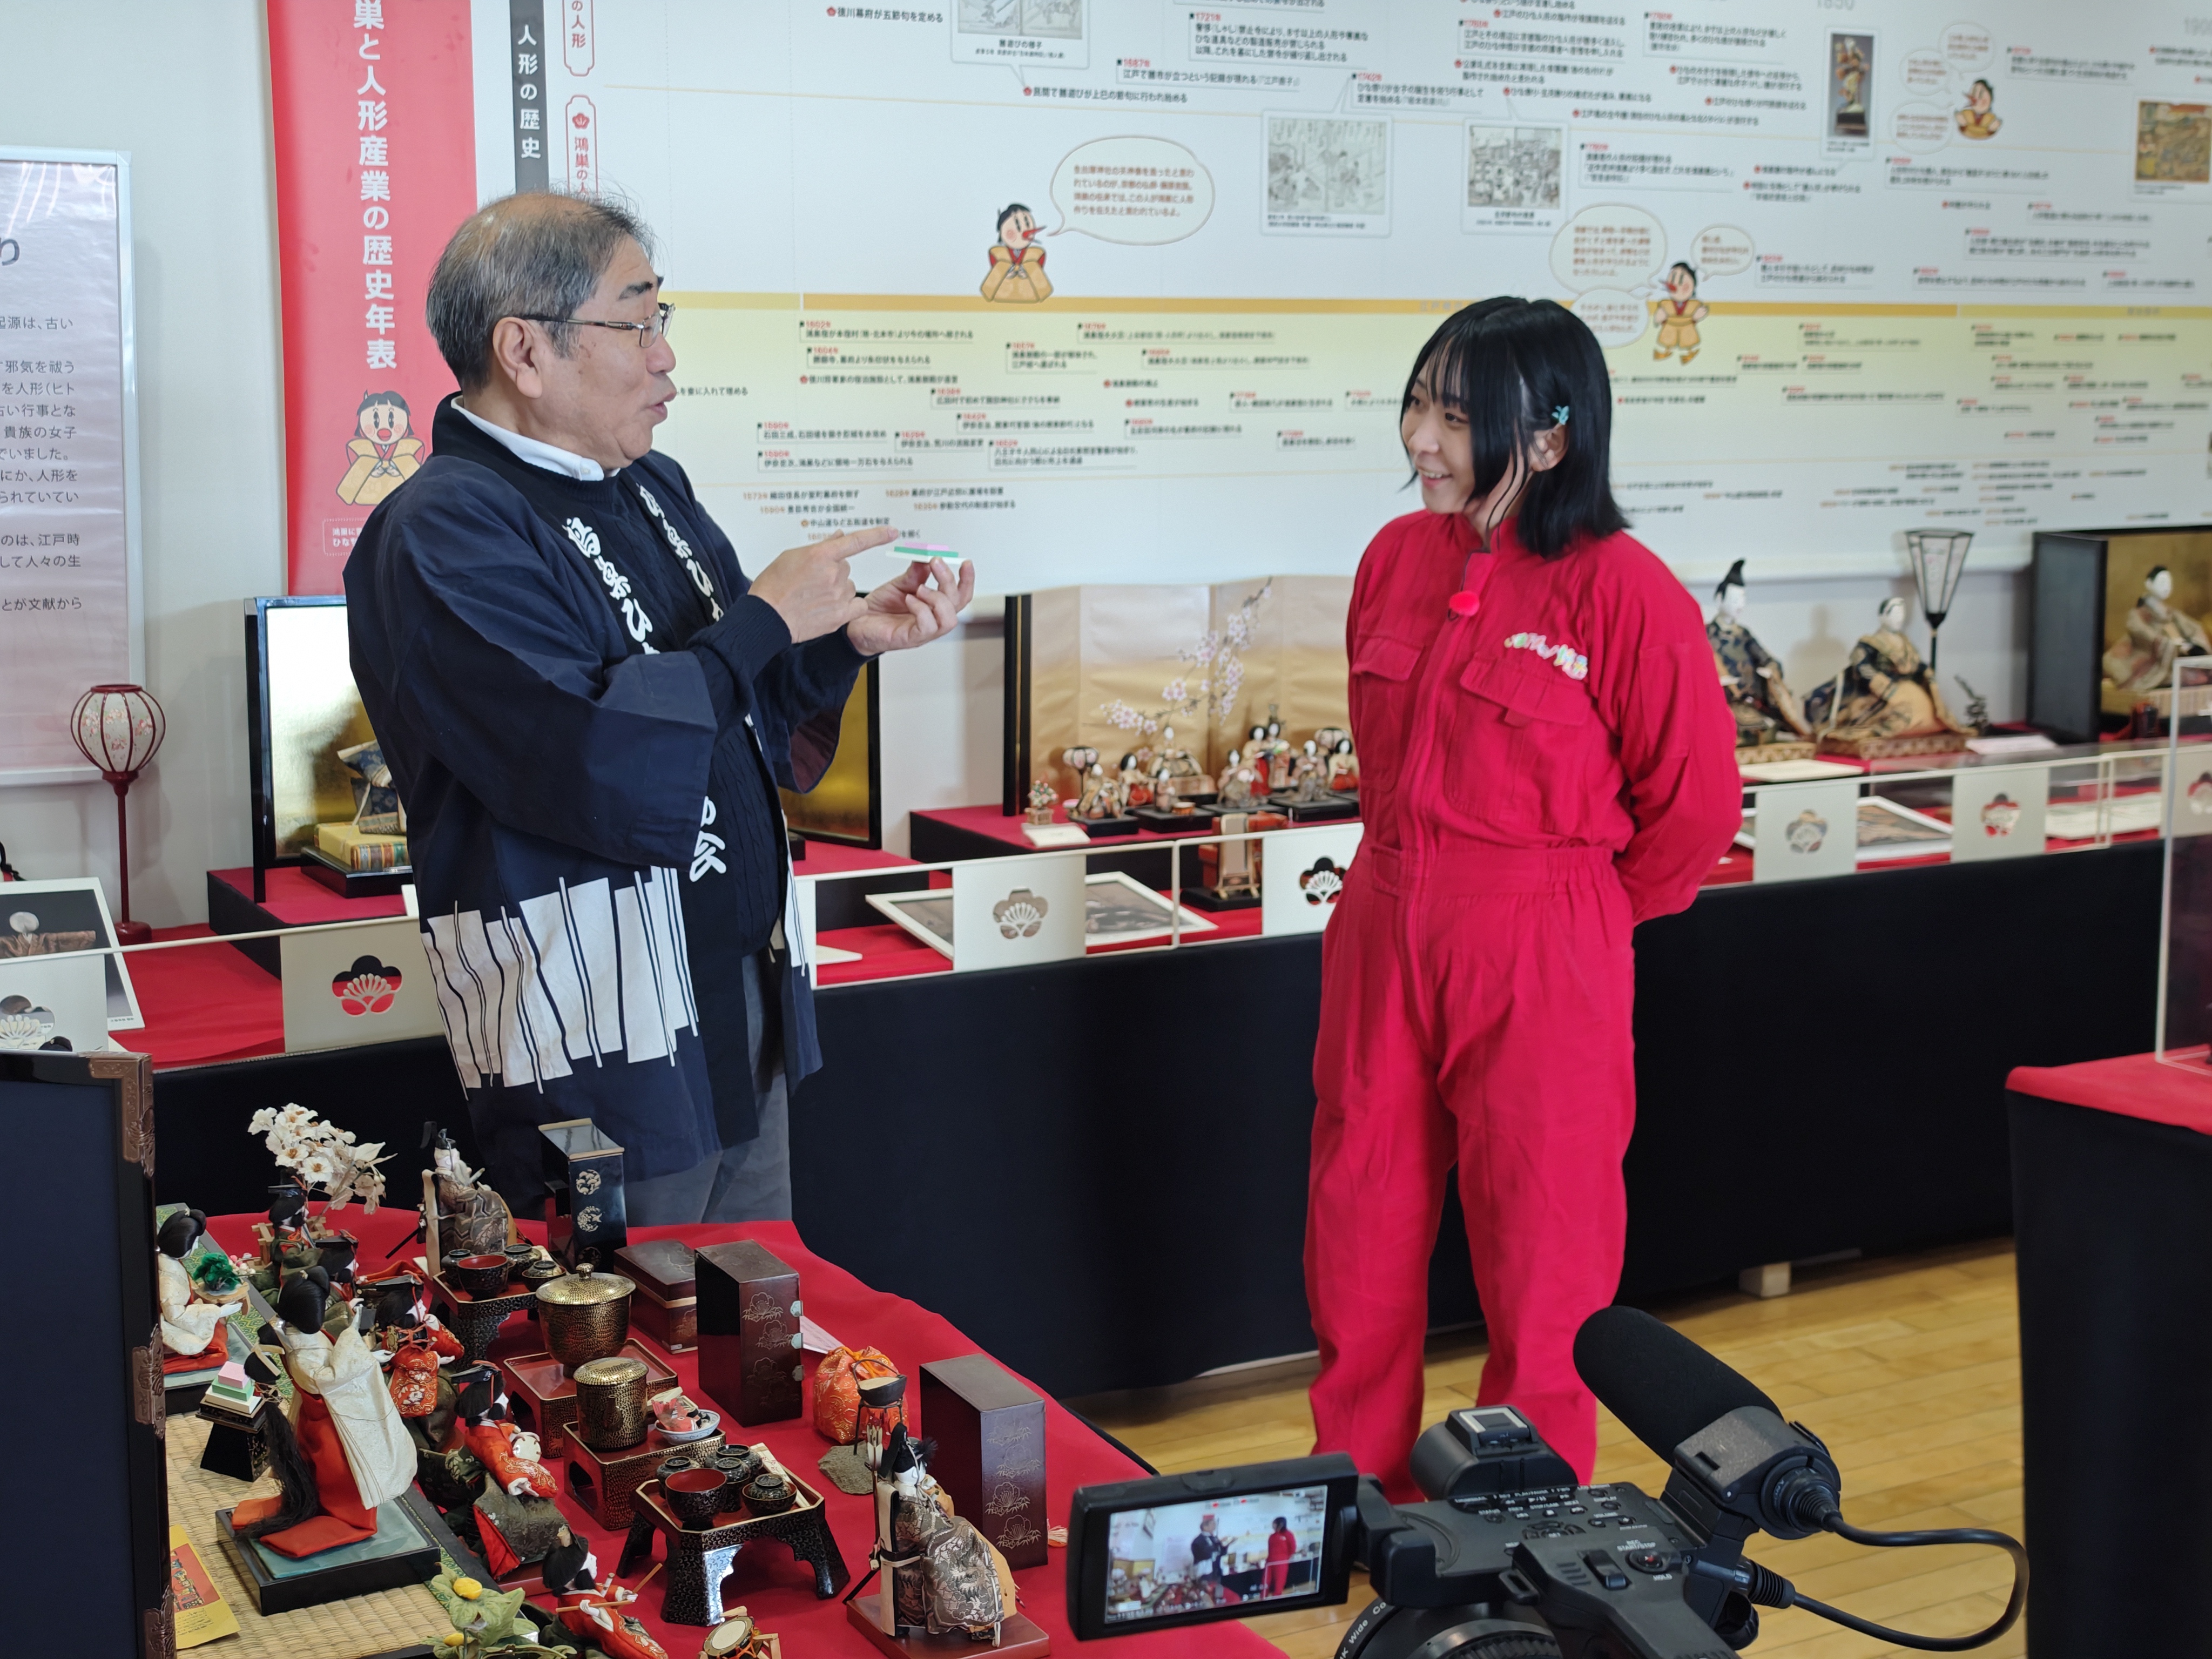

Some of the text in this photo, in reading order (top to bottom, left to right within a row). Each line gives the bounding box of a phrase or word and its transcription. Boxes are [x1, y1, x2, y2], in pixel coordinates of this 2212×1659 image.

[518, 24, 541, 159] 人形の歴史
[2, 381, 75, 395] を人形(ヒト
[0, 404, 76, 417] い行事とな
[4, 426, 78, 440] 貴族の女子
[1, 469, 78, 482] にか、人形を
[1, 533, 80, 547] のは、江戸時
[0, 555, 82, 568] して人々の生
[2, 597, 82, 611] とが文献から
[1616, 1542, 1657, 1552] START/STOP
[1653, 1573, 1673, 1581] HOLD
[1348, 1620, 1368, 1644] Wide
